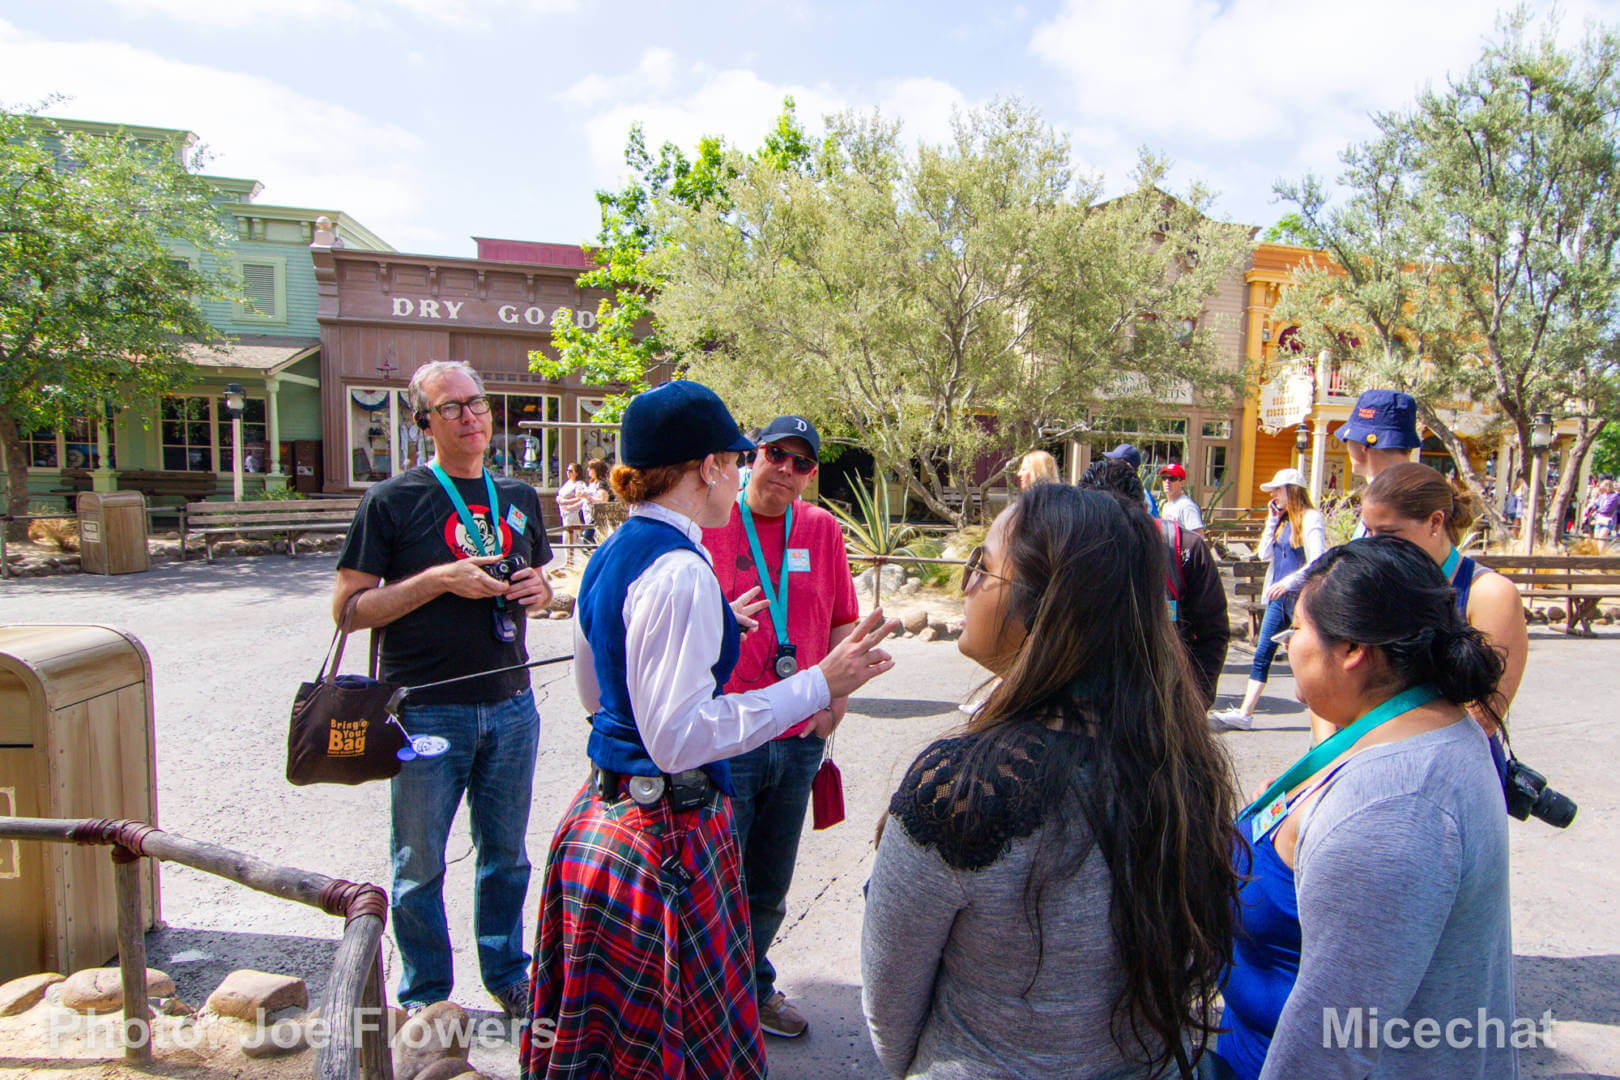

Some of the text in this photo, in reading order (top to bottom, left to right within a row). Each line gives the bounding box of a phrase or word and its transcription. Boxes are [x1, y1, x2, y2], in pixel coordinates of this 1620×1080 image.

[392, 298, 464, 320] DRY
[795, 418, 807, 432] D
[330, 718, 360, 730] Bring
[328, 729, 366, 752] Bag
[343, 729, 367, 739] Your
